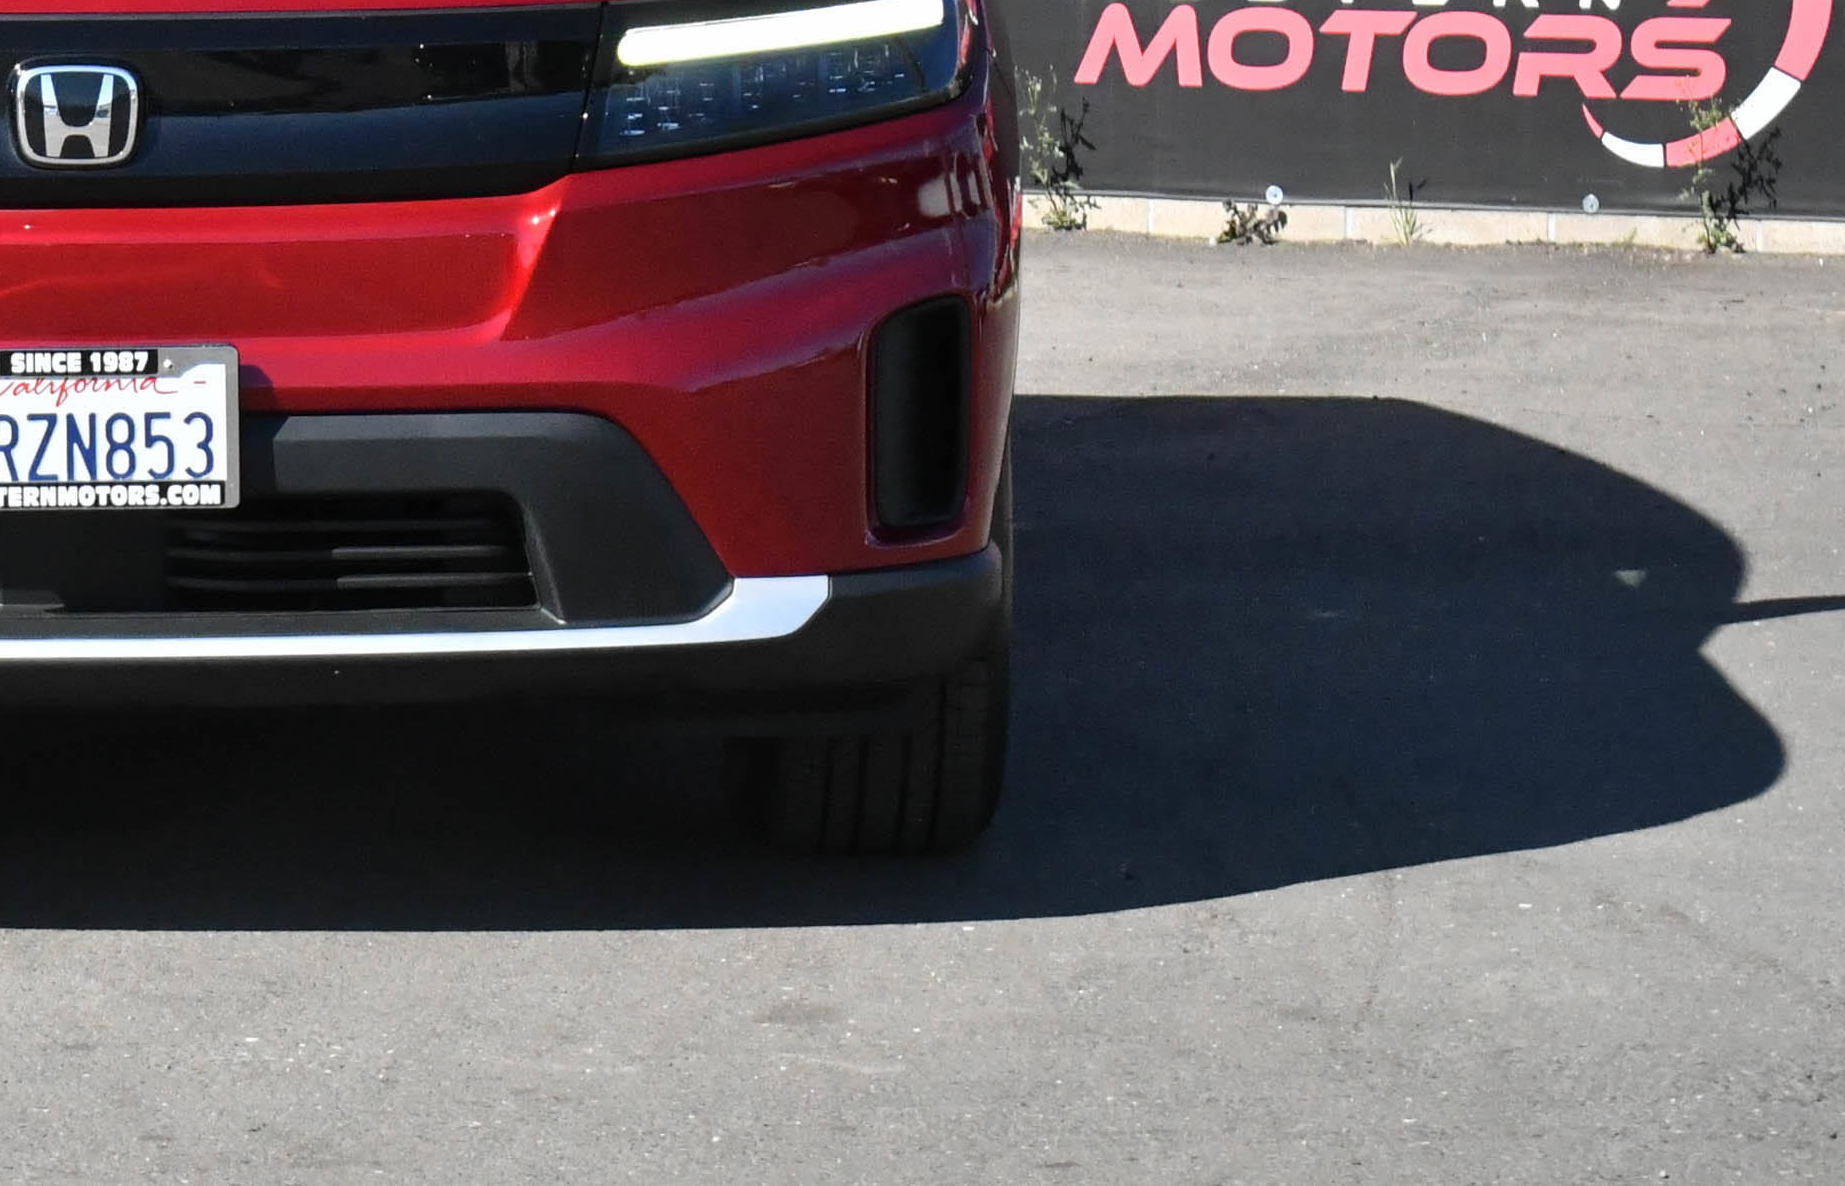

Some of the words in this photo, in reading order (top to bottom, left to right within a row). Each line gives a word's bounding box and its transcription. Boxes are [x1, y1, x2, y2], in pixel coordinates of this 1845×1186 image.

[1074, 2, 1732, 102] MOTORS
[10, 352, 84, 373] SINCE
[90, 351, 150, 373] 1987
